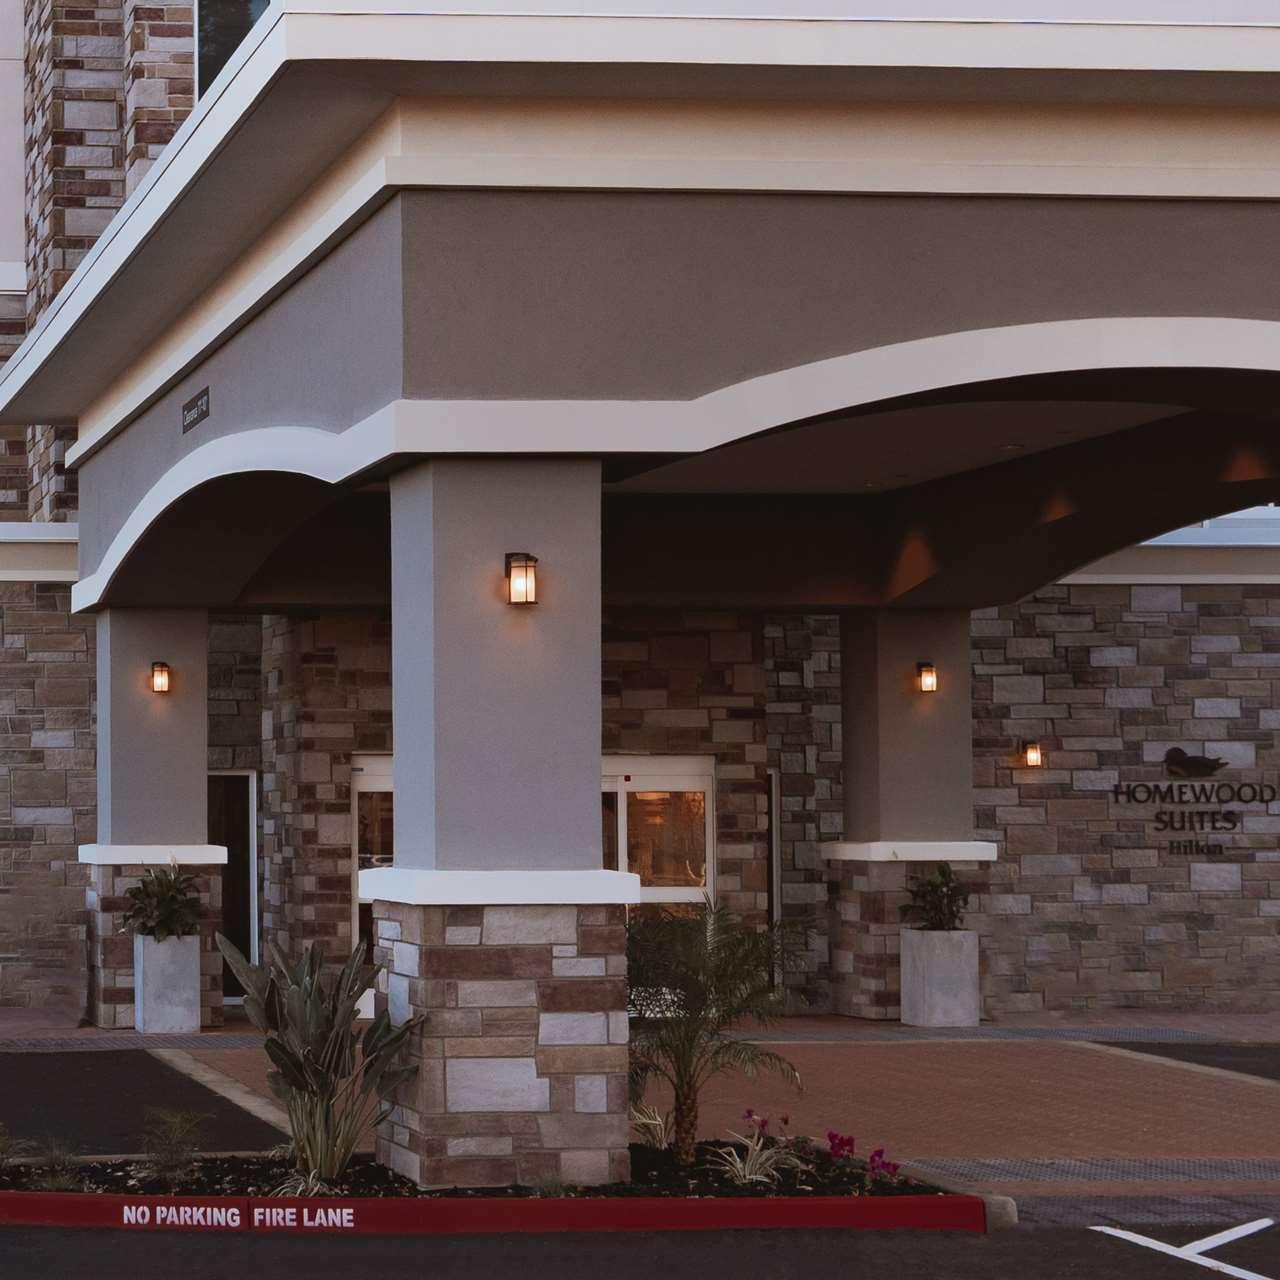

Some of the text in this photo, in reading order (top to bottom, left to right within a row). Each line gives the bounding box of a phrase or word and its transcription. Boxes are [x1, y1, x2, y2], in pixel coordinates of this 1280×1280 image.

[1113, 783, 1276, 804] HOMEWOOD
[1153, 810, 1238, 832] SUITES
[123, 1205, 355, 1228] NO PARKING FIRE LANE
